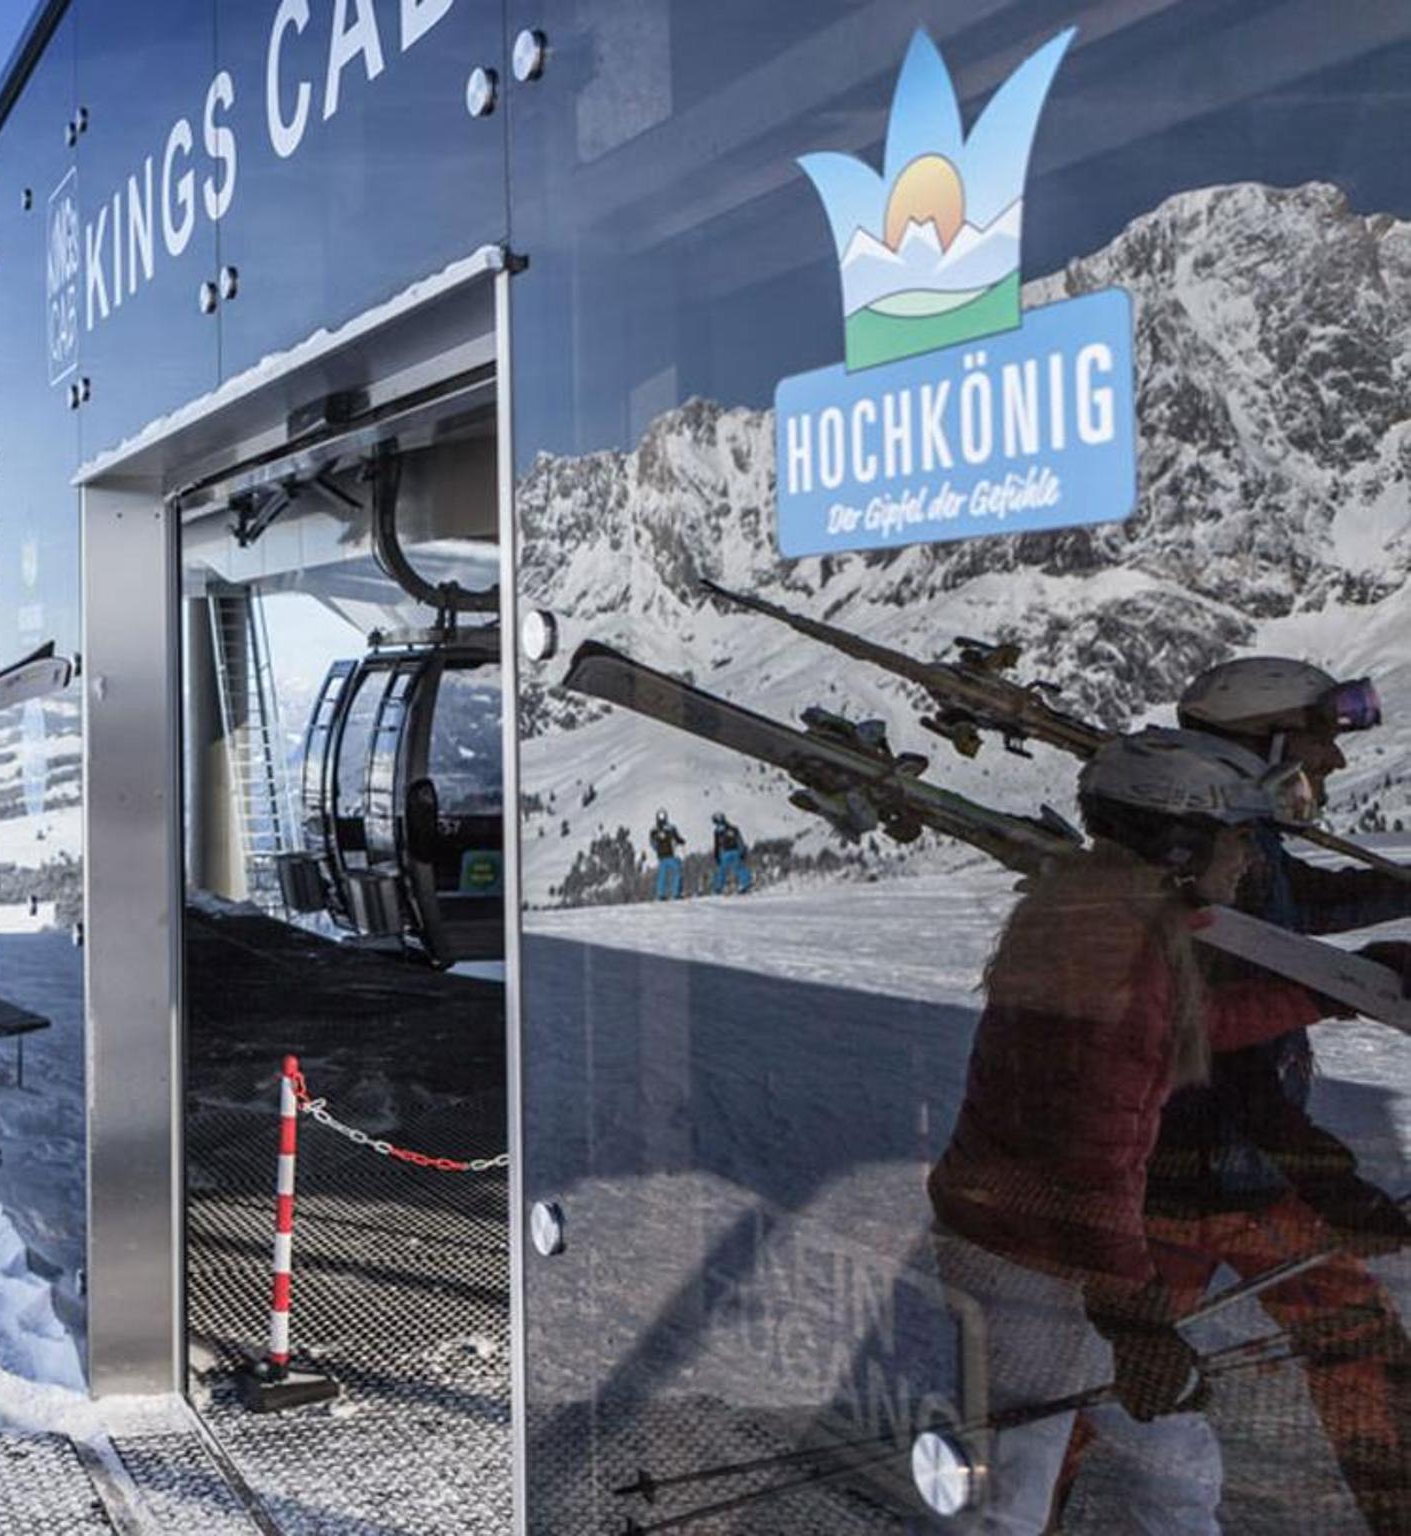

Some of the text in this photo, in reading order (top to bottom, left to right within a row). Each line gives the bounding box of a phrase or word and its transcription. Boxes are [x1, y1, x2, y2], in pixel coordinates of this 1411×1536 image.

[85, 0, 454, 331] KINGS CA
[786, 343, 1115, 495] HOCHKÖNIG
[826, 465, 1062, 539] Der Gipfel der Gefühle
